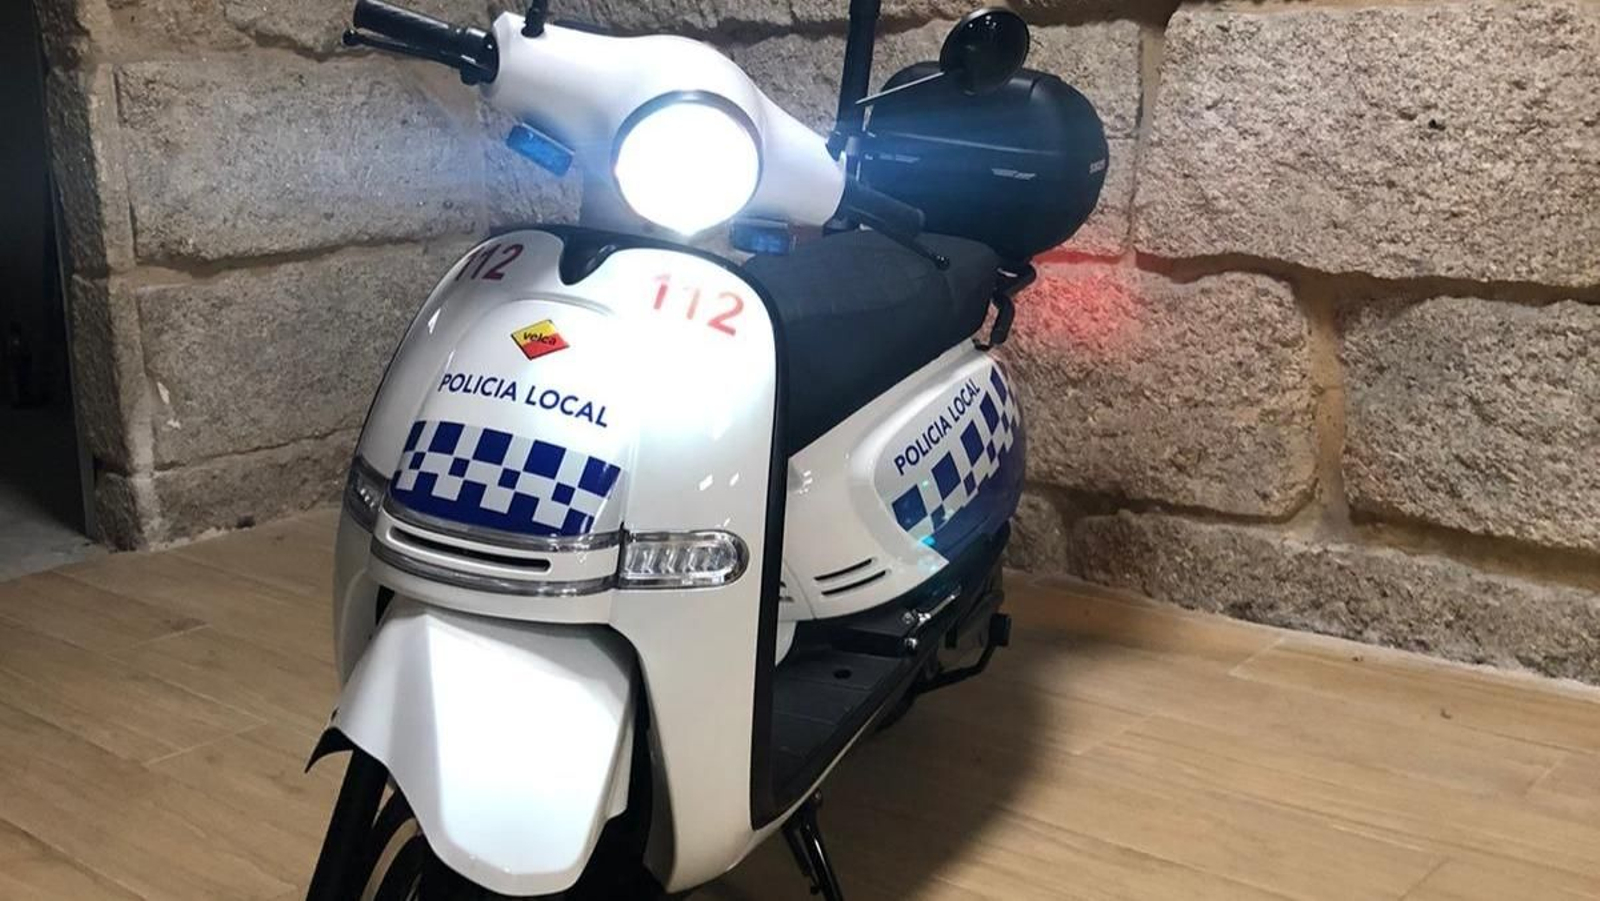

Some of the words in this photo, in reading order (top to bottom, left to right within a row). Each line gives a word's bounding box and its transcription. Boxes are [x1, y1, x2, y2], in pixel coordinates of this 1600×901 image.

[456, 243, 524, 281] 112
[652, 273, 744, 336] 112
[438, 373, 517, 401] POLICIA
[525, 385, 607, 428] LOCAL
[894, 415, 952, 476] POLICIA
[948, 378, 980, 422] LOCAL
